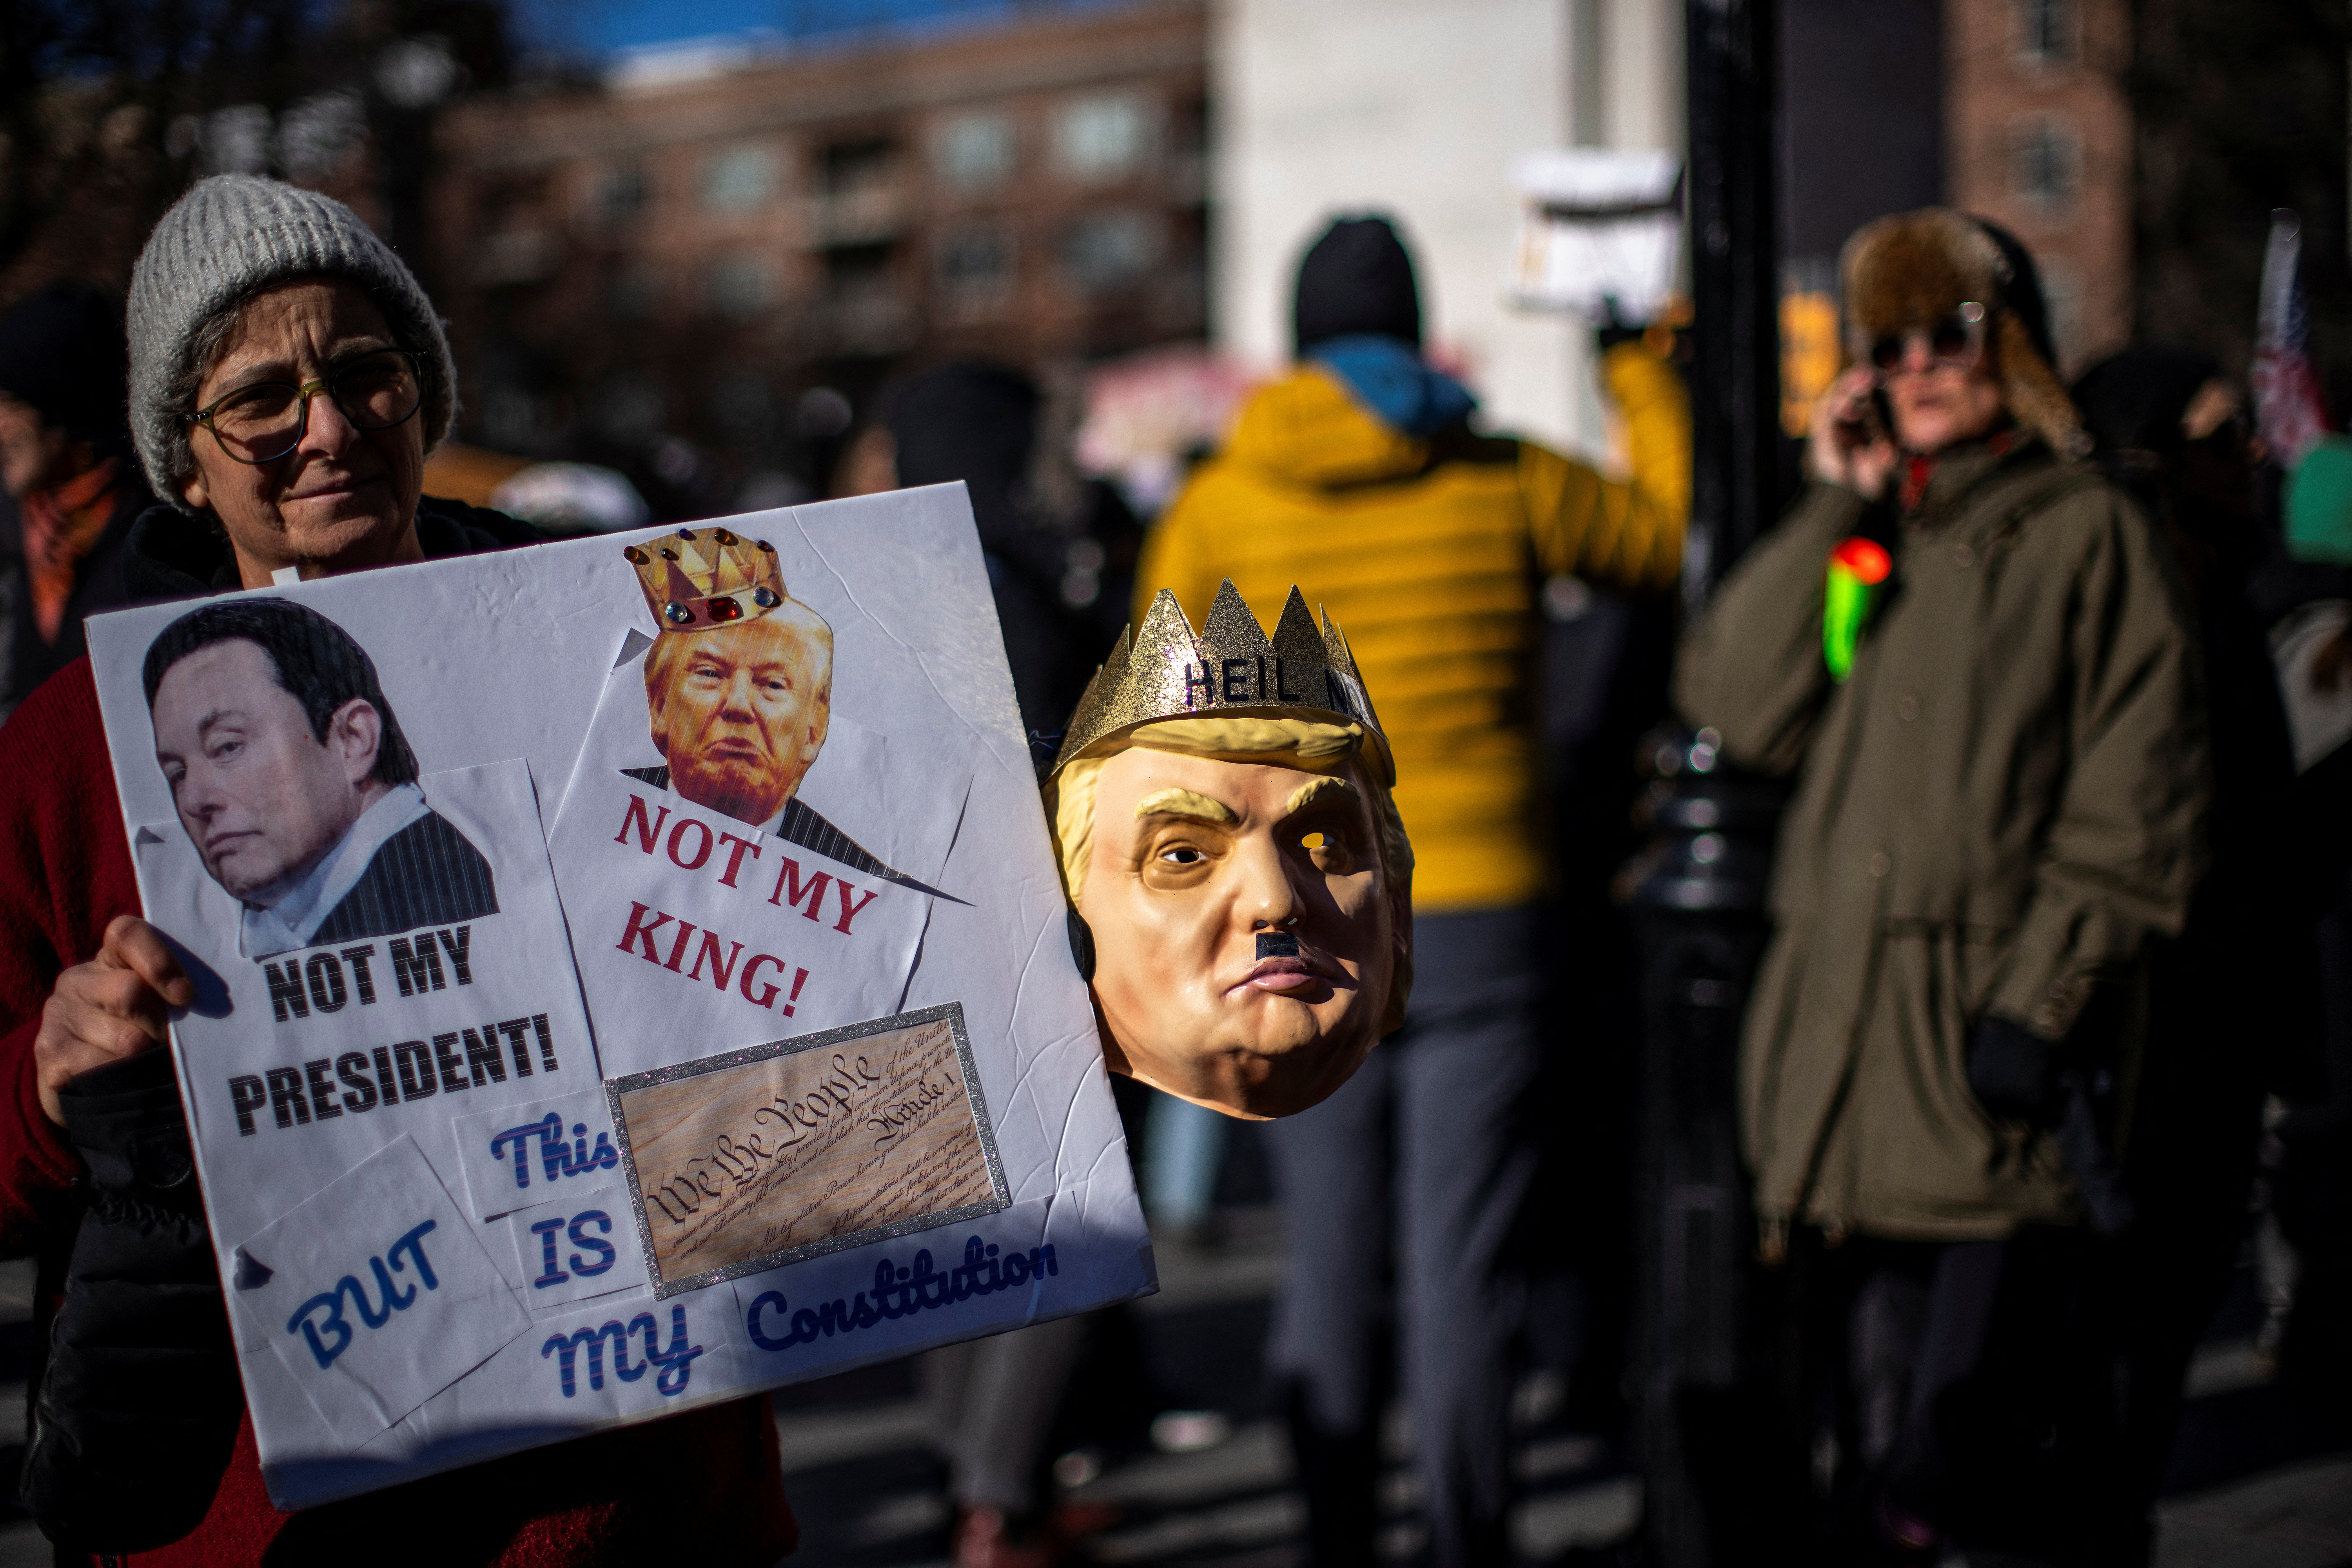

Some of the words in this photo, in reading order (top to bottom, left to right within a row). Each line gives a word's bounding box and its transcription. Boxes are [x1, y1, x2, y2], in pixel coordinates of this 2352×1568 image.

[1185, 656, 1300, 706] HEIL
[614, 793, 762, 889] NOT
[768, 856, 879, 936] MY
[263, 944, 377, 1023] NOT
[388, 924, 473, 998] MY
[615, 900, 810, 1018] KING!
[228, 1013, 559, 1137] PRESIDENT!
[490, 1112, 620, 1189] This
[647, 1155, 723, 1232] We
[712, 1133, 775, 1192] the
[755, 1054, 881, 1163] People
[886, 1050, 898, 1079] of
[899, 1038, 915, 1063] the
[673, 1225, 699, 1248] insure
[700, 1193, 738, 1229] domestic
[828, 1115, 841, 1139] for
[855, 1082, 889, 1112] common
[681, 1239, 699, 1259] and
[770, 1167, 800, 1191] ordain
[800, 1148, 818, 1169] and
[818, 1120, 856, 1155] establish
[856, 1108, 869, 1127] this
[872, 1077, 920, 1114] Constitution
[920, 1063, 933, 1087] for
[933, 1051, 944, 1069] the
[757, 1226, 778, 1252] All
[780, 1198, 824, 1241] legislative
[857, 1155, 880, 1177] herein
[912, 1111, 932, 1133] shall
[933, 1105, 941, 1118] be
[942, 1085, 967, 1111] vested
[838, 1177, 899, 1227] Representatives
[900, 1158, 922, 1180] shall
[923, 1152, 932, 1163] be
[932, 1124, 965, 1157] composed
[965, 1117, 974, 1137] of
[876, 1185, 906, 1218] requisite
[906, 1179, 918, 1197] for
[918, 1161, 943, 1183] Electors
[944, 1153, 953, 1169] of
[951, 1144, 961, 1159] the
[962, 1132, 979, 1149] most
[942, 1166, 956, 1182] not
[956, 1158, 975, 1172] have
[287, 1219, 439, 1370] BUT
[530, 1209, 616, 1289] IS
[747, 1235, 1059, 1352] Constitution
